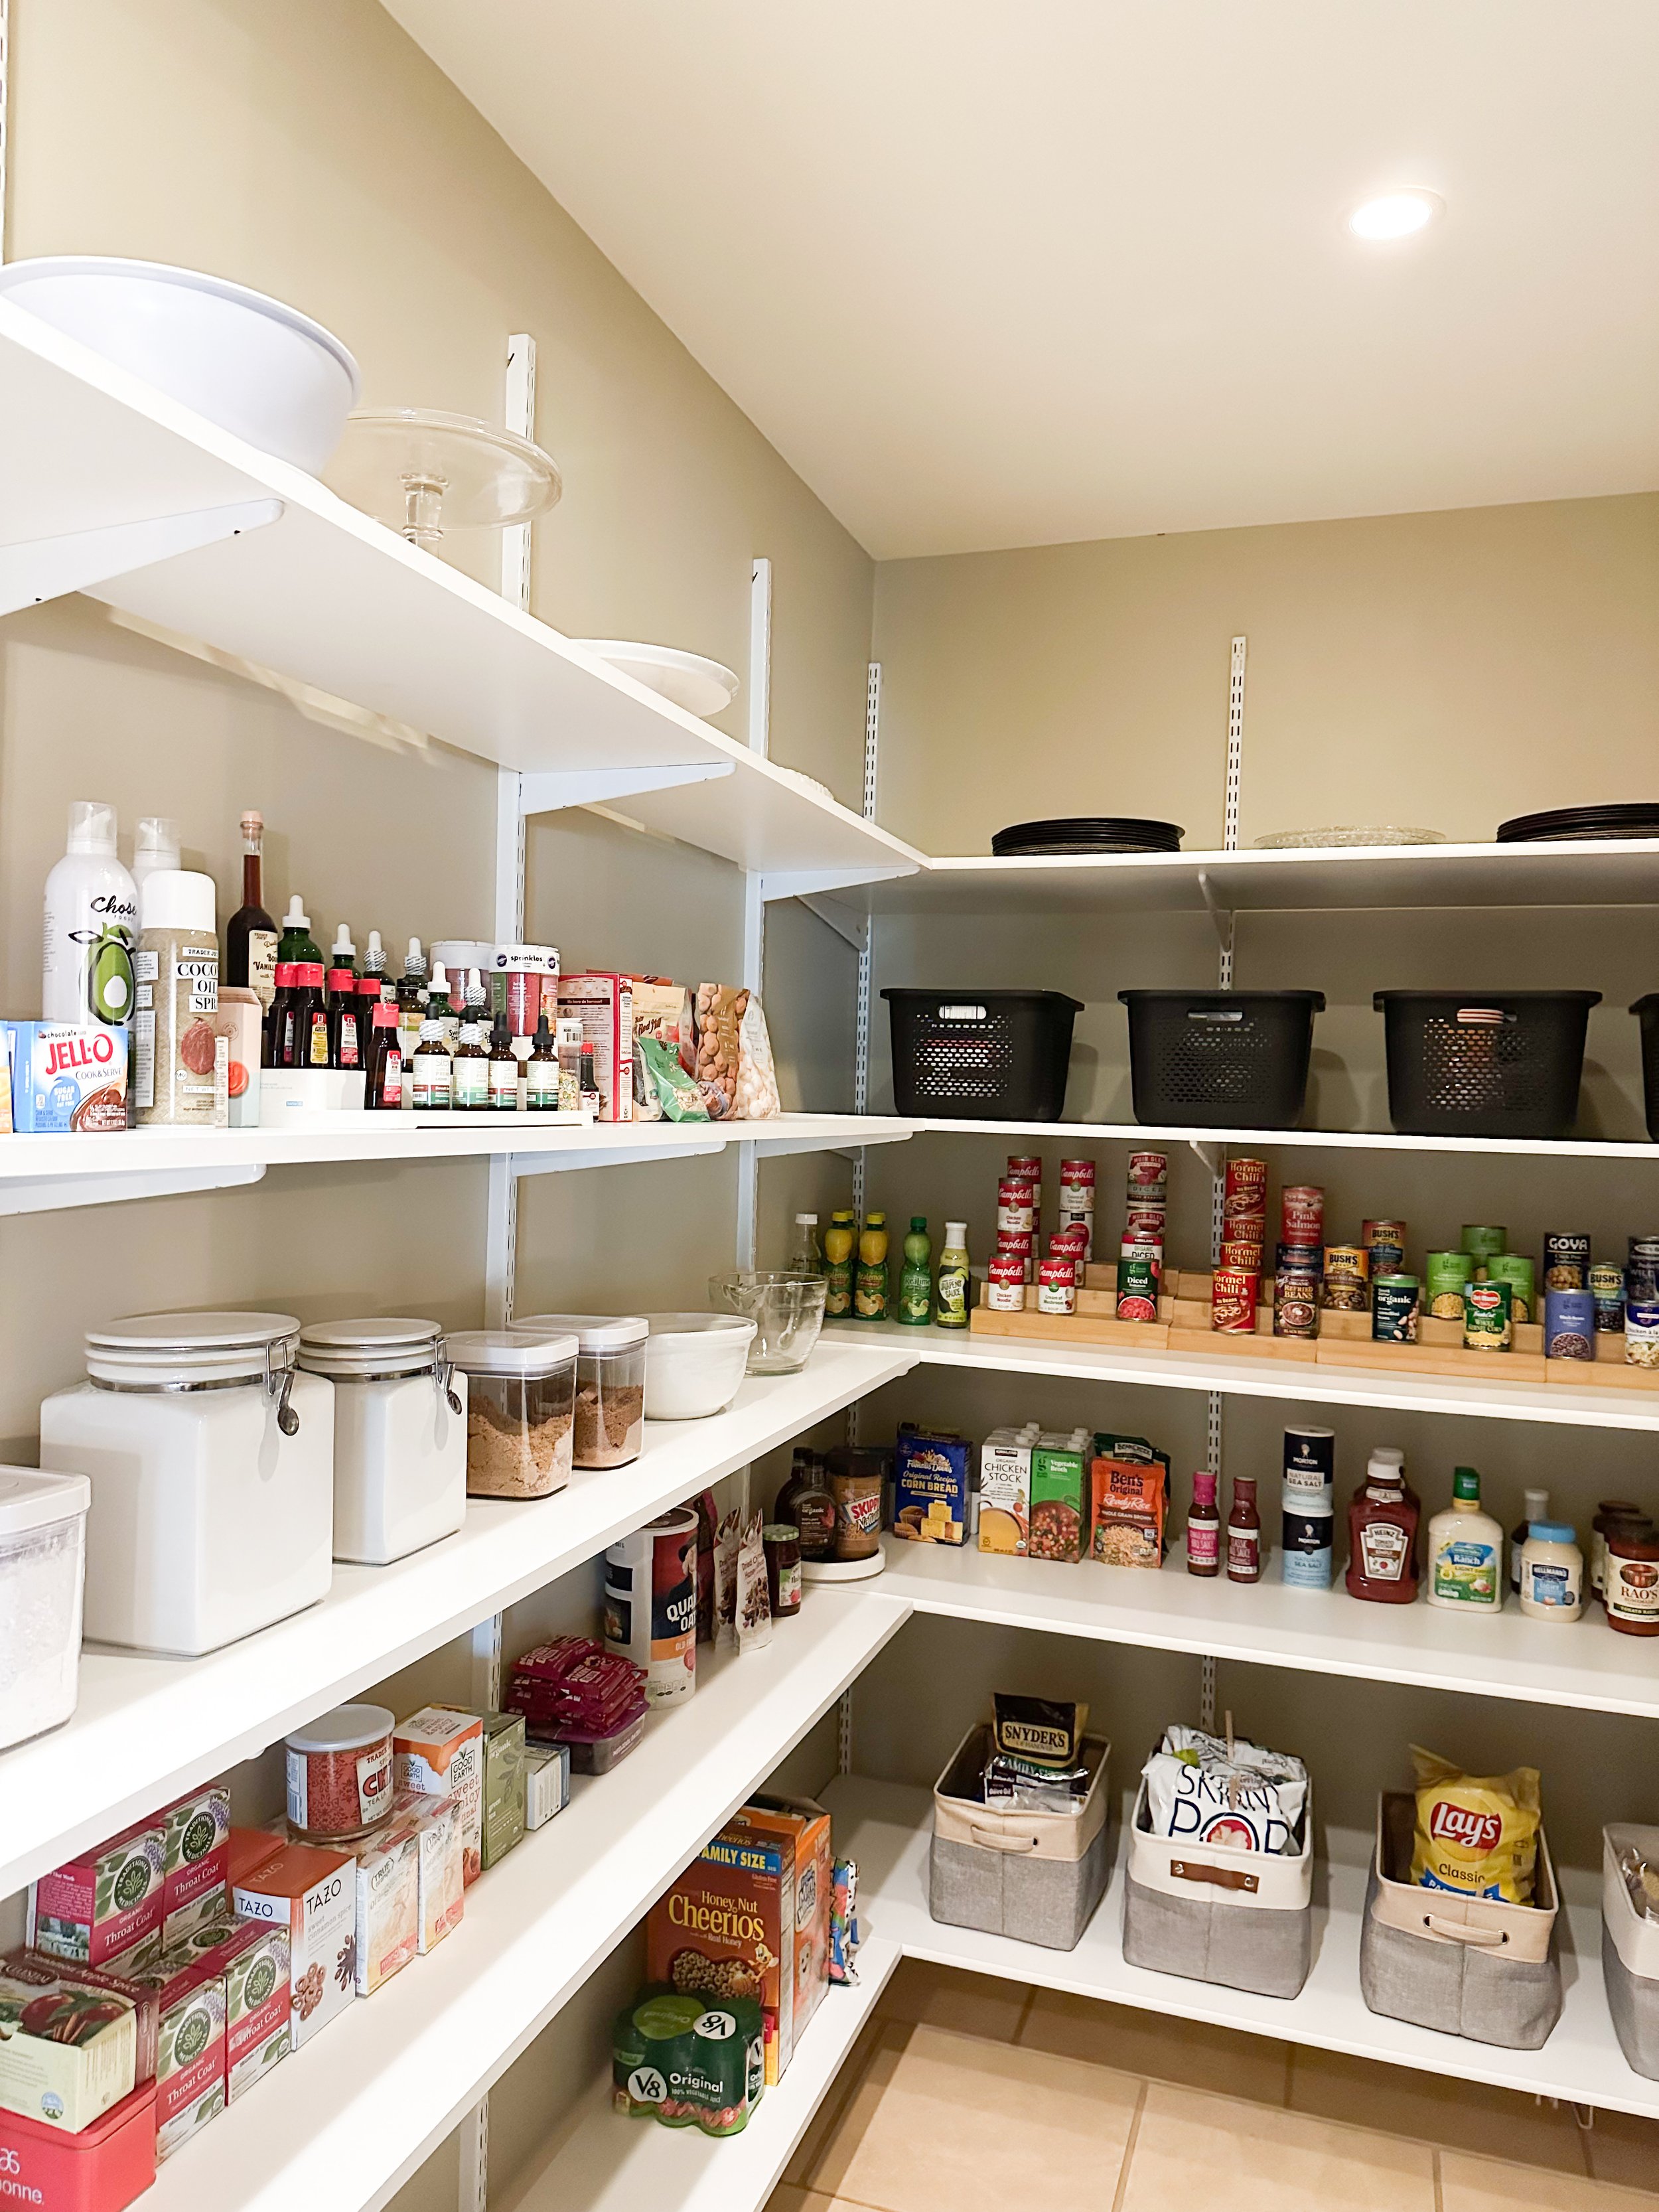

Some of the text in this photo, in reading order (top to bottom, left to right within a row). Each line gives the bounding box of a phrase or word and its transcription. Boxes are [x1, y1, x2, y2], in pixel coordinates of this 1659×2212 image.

[197, 980, 217, 994] OIL
[638, 1017, 663, 1035] Red Mill
[47, 1030, 77, 1039] chocolate
[54, 1086, 75, 1094] SUGAR
[1061, 1167, 1094, 1179] Campbell's
[1230, 1162, 1264, 1173] Hormel
[1235, 1172, 1259, 1181] Chili
[999, 1188, 1033, 1201] Campbell's
[1292, 1210, 1315, 1220] Pink
[1230, 1220, 1263, 1230] Hormel
[1286, 1219, 1321, 1229] Salmon
[1234, 1230, 1259, 1240] Chili
[1372, 1229, 1400, 1239] BUSH'S
[1050, 1240, 1084, 1253] Campbell's
[1225, 1246, 1260, 1256] Hormel
[1549, 1238, 1588, 1250] GOYA
[1230, 1256, 1256, 1266] Chili
[1329, 1254, 1358, 1265] BUSH'S
[989, 1264, 1023, 1278] Campbell's
[1039, 1266, 1074, 1279] Campbell's
[1590, 1274, 1623, 1285] BUSH'S
[946, 1288, 961, 1298] SAUCE
[1215, 1283, 1239, 1293] Chili
[1378, 1295, 1411, 1305] organic
[985, 1463, 1027, 1474] CHICKEN
[1050, 1459, 1078, 1468] Vegetable
[902, 1470, 957, 1484] Original Recipe
[989, 1473, 1022, 1483] STOCK
[1111, 1471, 1143, 1487] Ben's
[902, 1479, 958, 1494] CORN BREAD
[1110, 1484, 1143, 1496] Original
[1453, 1554, 1480, 1565] Ranch
[1621, 1586, 1658, 1599] RAO'S
[676, 1641, 685, 1651] OLD
[1005, 1726, 1066, 1747] SNYDER'S
[366, 1747, 388, 1764] TRADER
[453, 1756, 472, 1773] GOOD
[1002, 1756, 1038, 1776] FAMILY
[453, 1764, 473, 1783] EARTH
[398, 1781, 426, 1791] sweet
[368, 1797, 380, 1807] TEA
[184, 1816, 213, 1841] TRADITIONAL
[1433, 1803, 1500, 1848] Lay's
[186, 1836, 213, 1860] MEDICINALS
[186, 1858, 210, 1876] ORGANIC
[740, 1852, 766, 1870] SIZE
[118, 1860, 149, 1888] TRADITIONAL
[174, 1864, 220, 1896] Throat Coat
[249, 1862, 284, 1883] TAZO
[374, 1862, 391, 1884] TRUE
[1439, 1863, 1486, 1883] Classic
[119, 1881, 147, 1907] MEDICINALS
[307, 1879, 342, 1915] TAZO
[701, 1891, 758, 1913] Honey Nut
[119, 1905, 145, 1924] ORGANIC
[239, 1897, 273, 1917] TAZO
[337, 1904, 352, 1920] spice
[668, 1895, 764, 1942] Cheerios
[104, 1909, 153, 1947] Throat Coat
[708, 1933, 743, 1949] Real Honey
[80, 1969, 109, 1982] Apple
[111, 1979, 140, 1992] Spice
[247, 1960, 273, 1989] TRADITIONAL
[250, 2002, 272, 2023] ORGANIC
[264, 2005, 282, 2025] Coat
[177, 2012, 208, 2043] TRADITIONAL
[701, 2015, 727, 2036] V8
[179, 2033, 208, 2062] MEDICINALS
[180, 2056, 205, 2081] ORGANIC
[167, 2060, 216, 2105] Throat Coat
[635, 2072, 661, 2098] V8
[669, 2072, 723, 2093] Original
